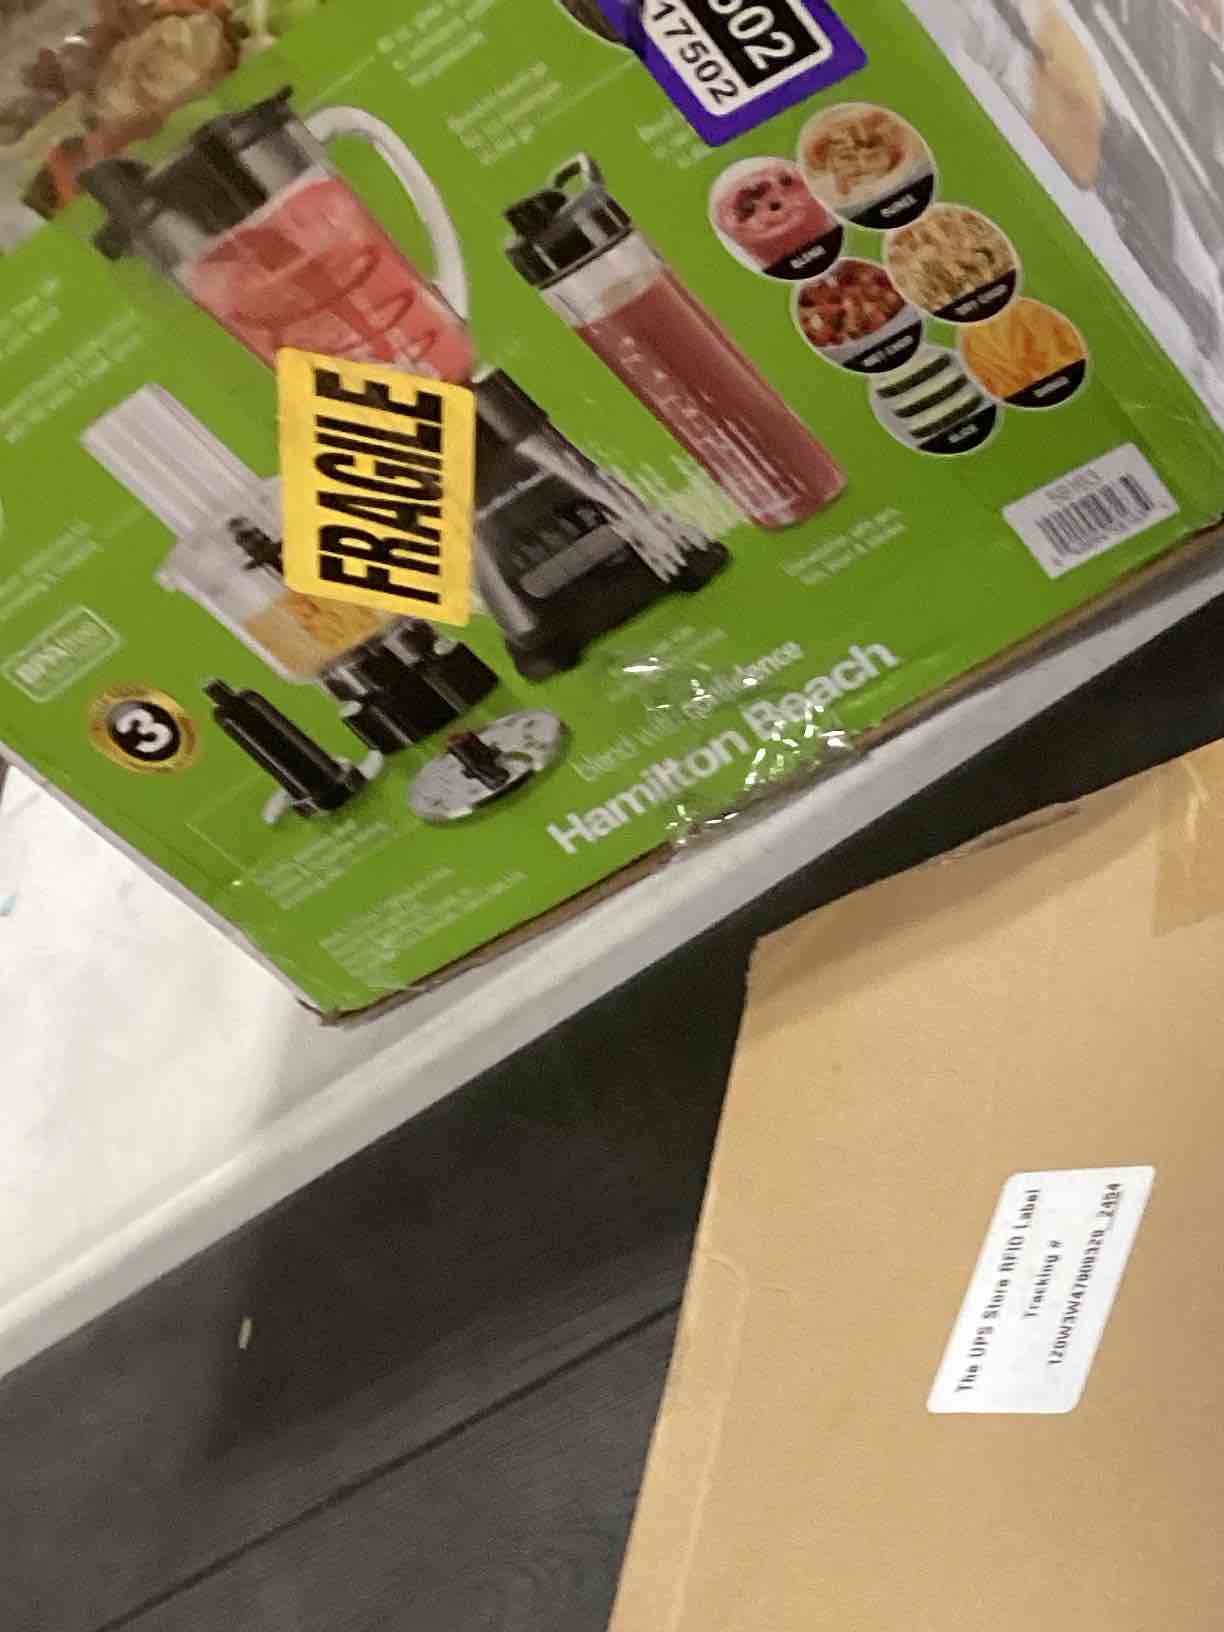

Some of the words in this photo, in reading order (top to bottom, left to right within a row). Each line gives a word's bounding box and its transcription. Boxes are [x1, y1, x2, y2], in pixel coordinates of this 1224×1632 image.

[314, 366, 443, 605] FRAGILE
[116, 707, 173, 754] 3
[546, 728, 751, 855] Hamilton
[741, 642, 900, 743] Beach
[956, 1364, 982, 1392] The
[969, 1325, 993, 1358] UPS
[983, 1278, 1010, 1320] Store
[1013, 1188, 1041, 1229] Label
[1022, 1254, 1063, 1318] Tracking
